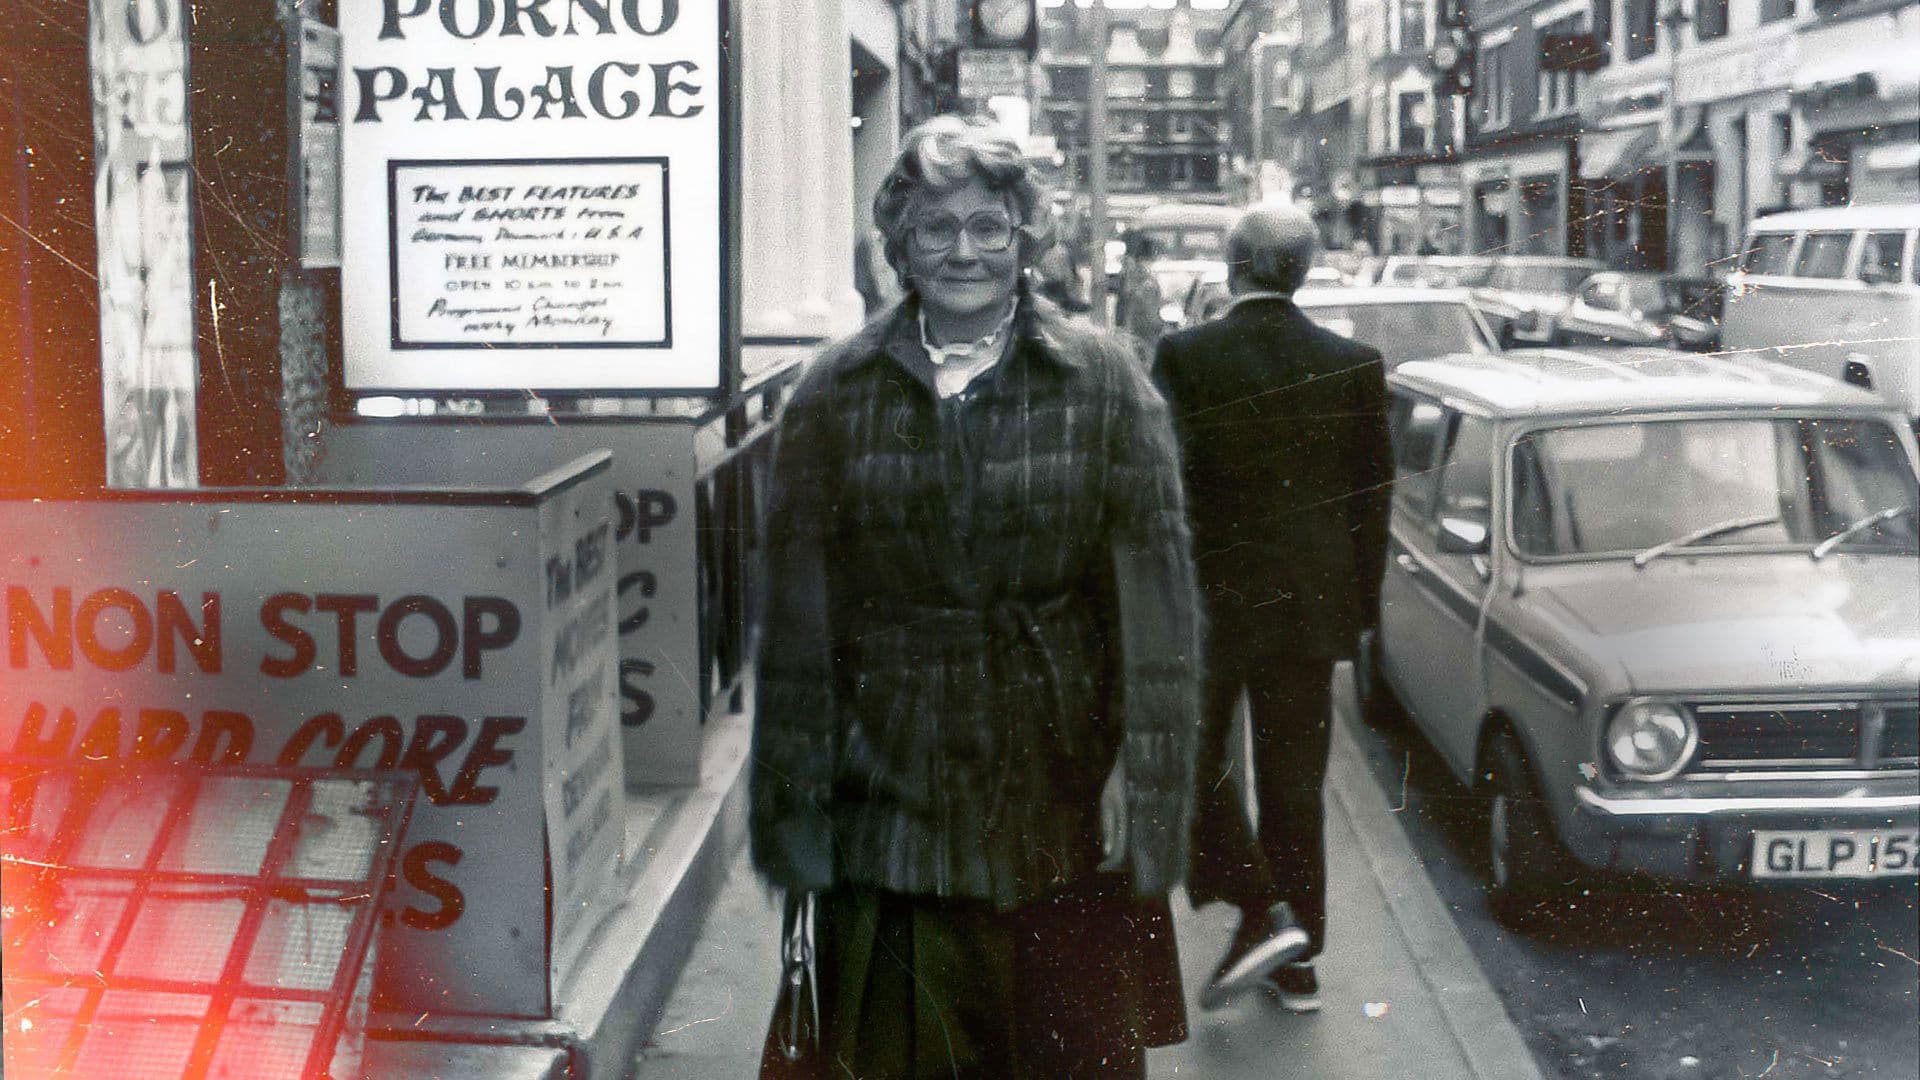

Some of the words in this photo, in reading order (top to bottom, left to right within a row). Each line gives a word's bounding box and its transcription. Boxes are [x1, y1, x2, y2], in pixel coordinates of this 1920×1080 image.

[378, 0, 680, 40] PORNO
[352, 60, 705, 122] PALACE
[458, 185, 516, 204] BEST
[523, 183, 641, 201] FEATURES
[445, 252, 494, 270] FREE
[501, 253, 621, 270] MEMBERSHIP
[7, 585, 223, 675] NON
[258, 592, 522, 680] STOP
[1767, 836, 1855, 872] GLP
